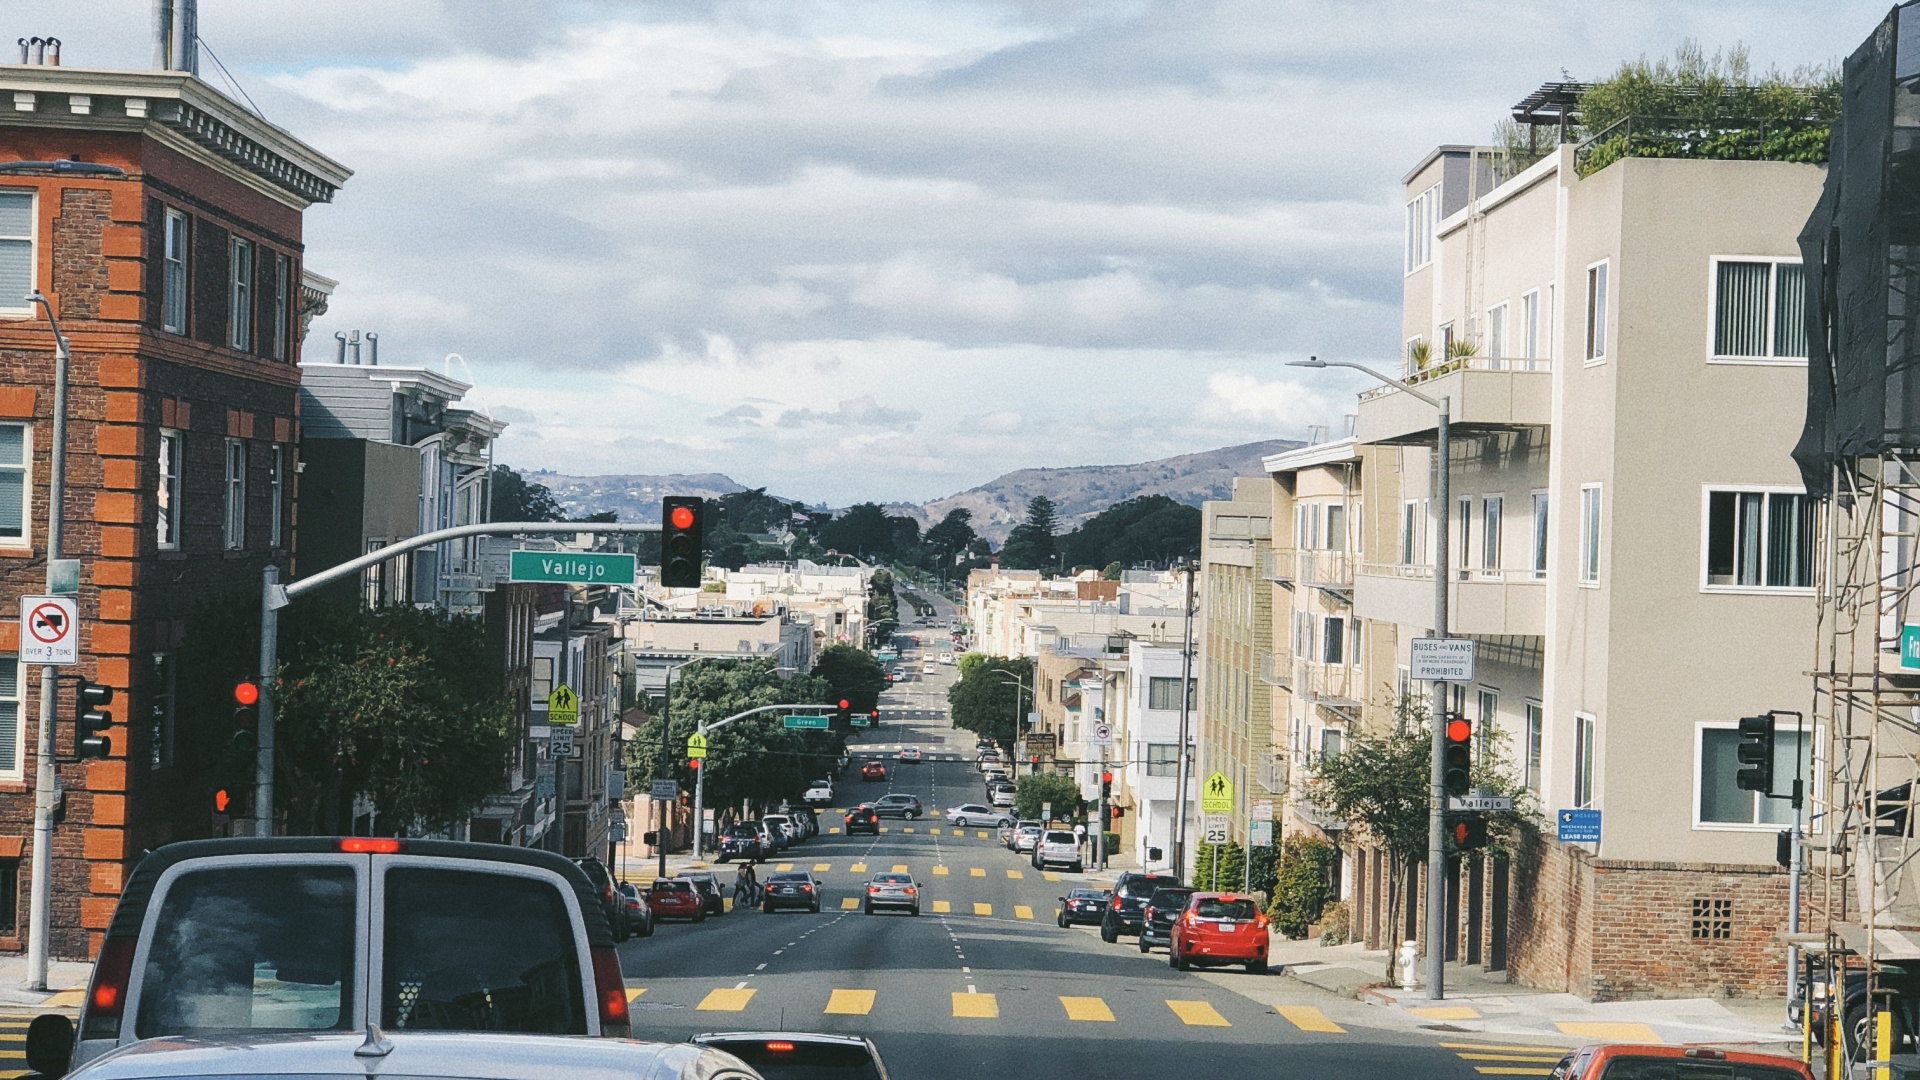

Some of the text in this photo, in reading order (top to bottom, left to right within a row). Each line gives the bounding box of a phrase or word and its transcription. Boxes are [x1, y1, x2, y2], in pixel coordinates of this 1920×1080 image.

[541, 559, 605, 581] Vallejo
[25, 645, 72, 657] OVER 3 TONS
[1413, 643, 1438, 652] BUSES
[1448, 643, 1472, 652] VANS
[1421, 666, 1464, 676] PROHIBITED
[549, 713, 576, 722] SCHOOL
[796, 718, 817, 726] Green
[552, 742, 572, 754] 25
[1203, 801, 1231, 809] SCHOOL
[1460, 799, 1502, 810] Vallejo
[1207, 830, 1226, 843] 25
